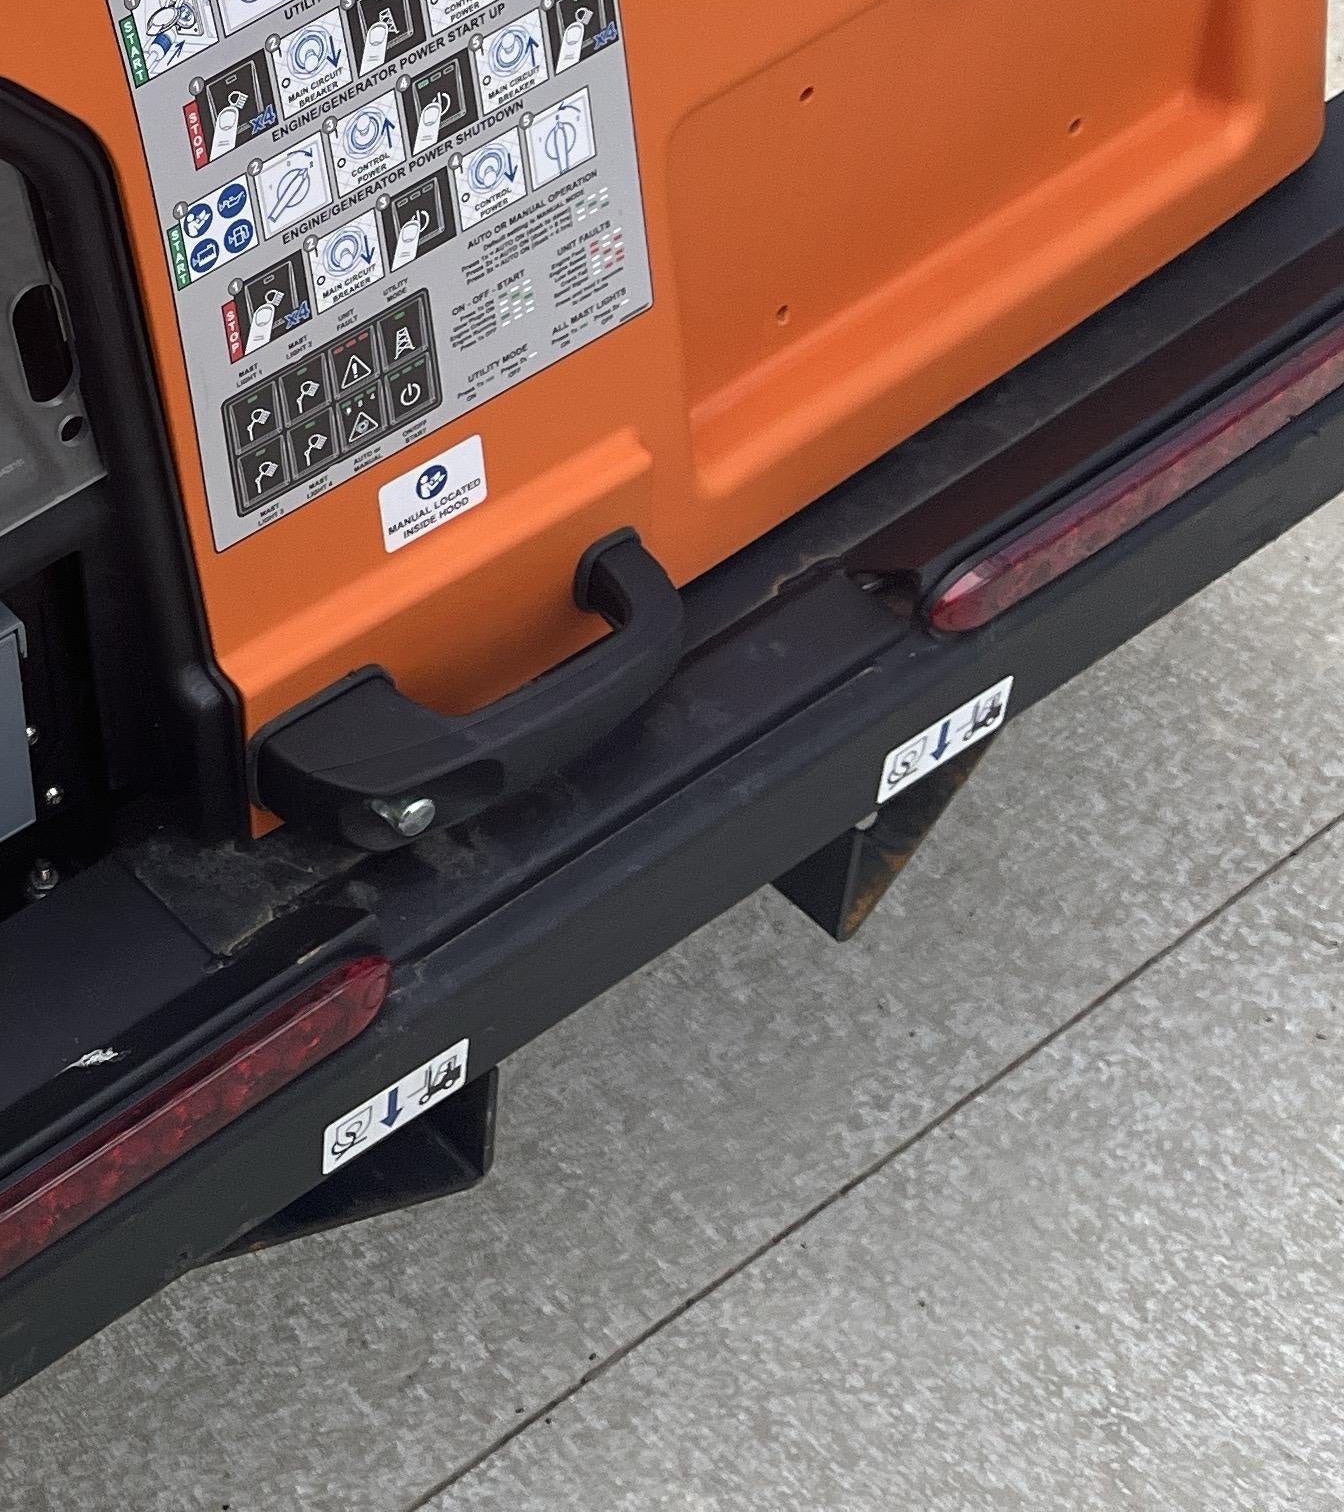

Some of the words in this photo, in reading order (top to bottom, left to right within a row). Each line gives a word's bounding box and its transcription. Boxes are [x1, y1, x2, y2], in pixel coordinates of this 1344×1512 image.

[449, 0, 480, 23] POWER
[122, 17, 145, 85] START
[267, 34, 278, 49] 2
[590, 20, 617, 51] x4
[191, 79, 202, 93] 1
[270, 61, 398, 144] ENGINE/GENERATOR
[398, 34, 446, 71] POWER
[446, 11, 487, 44] START
[487, 0, 506, 21] UP
[287, 84, 308, 104] MAIN
[308, 65, 343, 92] CIRCUIT
[397, 74, 409, 91] 4
[487, 82, 508, 100] MAIN
[508, 64, 541, 88] CIRCUIT
[297, 79, 339, 108] BREAKER
[497, 77, 535, 105] BREAKER
[248, 102, 277, 135] x4
[324, 117, 335, 132] 3
[187, 110, 205, 160] STOP
[249, 159, 261, 174] 2
[280, 164, 407, 246] ENGINE/GENERATOR
[407, 137, 454, 173] POWER
[454, 97, 525, 146] SHUTDOWN
[350, 149, 390, 179] CONTROL
[356, 161, 387, 185] POWER
[449, 153, 461, 169] 4
[175, 203, 185, 216] 1
[377, 195, 388, 210] 3
[466, 228, 493, 250] AUTO
[493, 220, 507, 235] OR
[508, 197, 546, 226] MANUAL
[546, 167, 598, 204] OPERATION
[473, 184, 512, 213] CONTROL
[479, 195, 509, 219] POWER
[304, 235, 316, 250] 2
[556, 238, 577, 257] UNIT
[578, 218, 611, 244] FAULTS
[169, 228, 189, 287] START
[321, 281, 343, 299] MAIN
[343, 262, 377, 287] CIRCUIT
[331, 275, 371, 303] BREAKER
[451, 302, 466, 317] ON
[471, 288, 490, 305] OFF
[495, 267, 526, 292] START
[282, 297, 311, 330] x4
[551, 319, 568, 335] ALL
[569, 304, 593, 325] MAST
[595, 286, 626, 311] LIGHTS
[225, 308, 242, 355] STOP
[467, 358, 500, 383] UTILITY
[501, 341, 529, 364] MODE
[388, 507, 432, 535] MANUAL
[433, 477, 481, 510] LOCATED
[403, 513, 438, 539] INSIDE
[438, 496, 469, 519] HOOD
